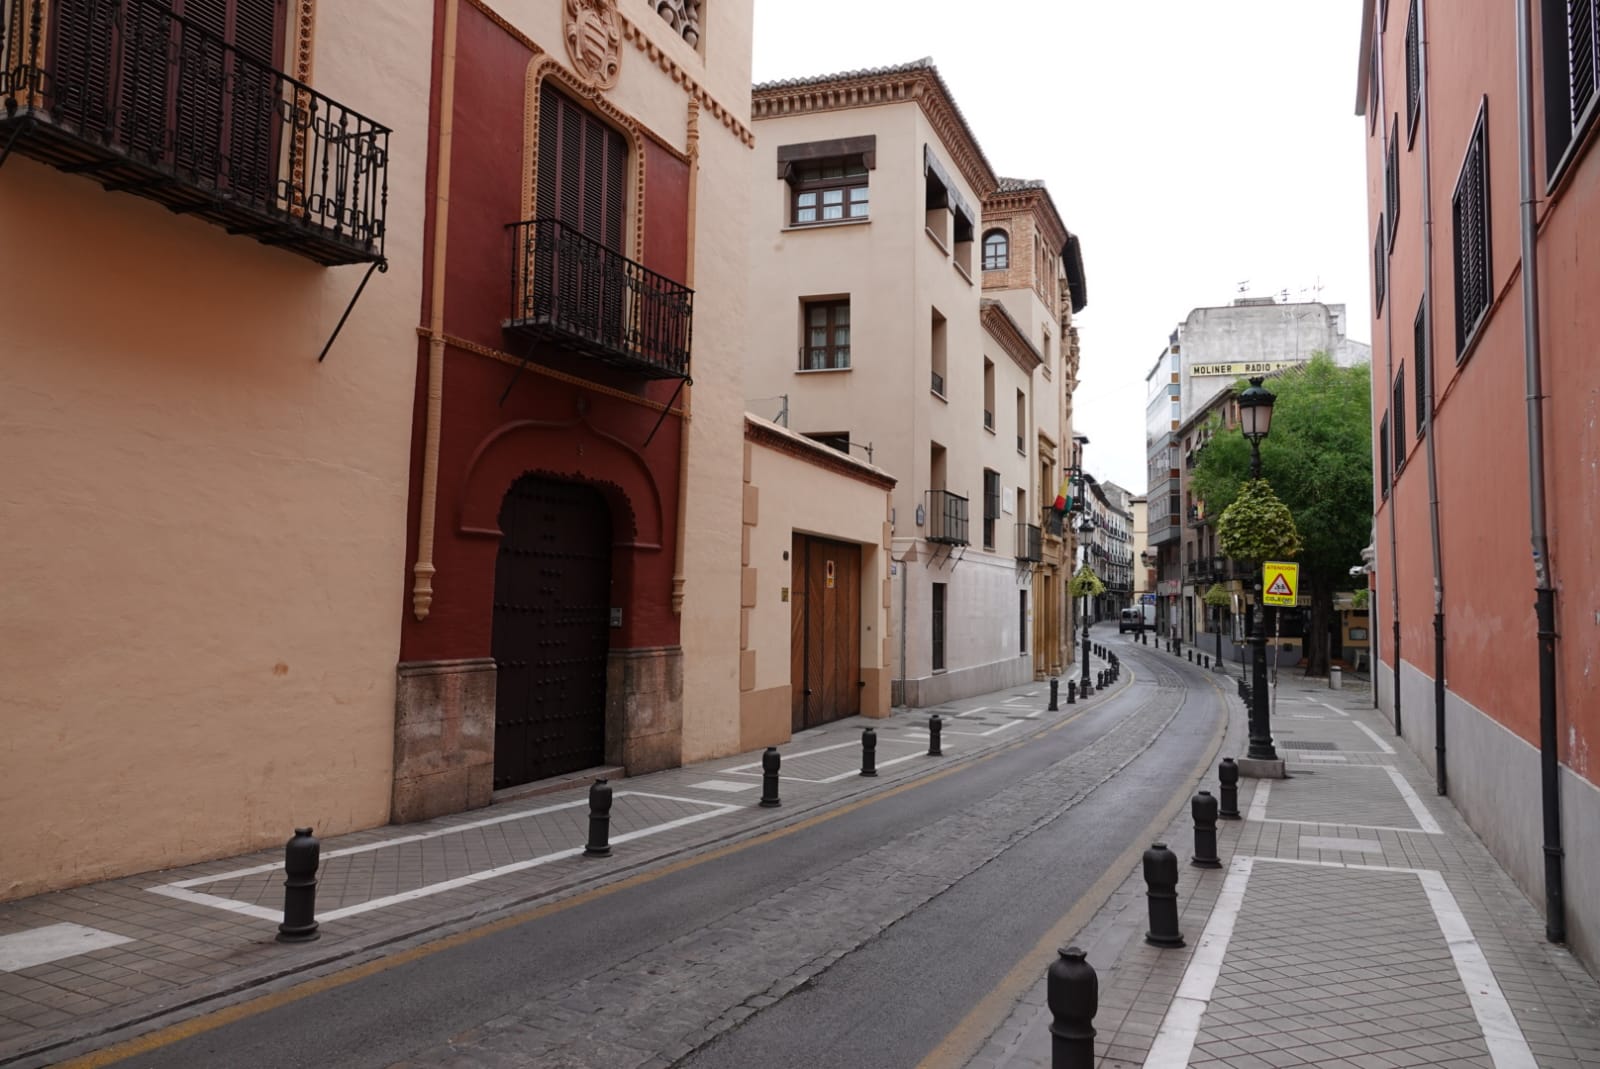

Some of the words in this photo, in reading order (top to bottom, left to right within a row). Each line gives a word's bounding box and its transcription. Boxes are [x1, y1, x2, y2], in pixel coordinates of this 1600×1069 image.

[1193, 365, 1232, 374] MOLINER
[1245, 363, 1271, 372] RADIO
[1264, 596, 1293, 604] COLEG
